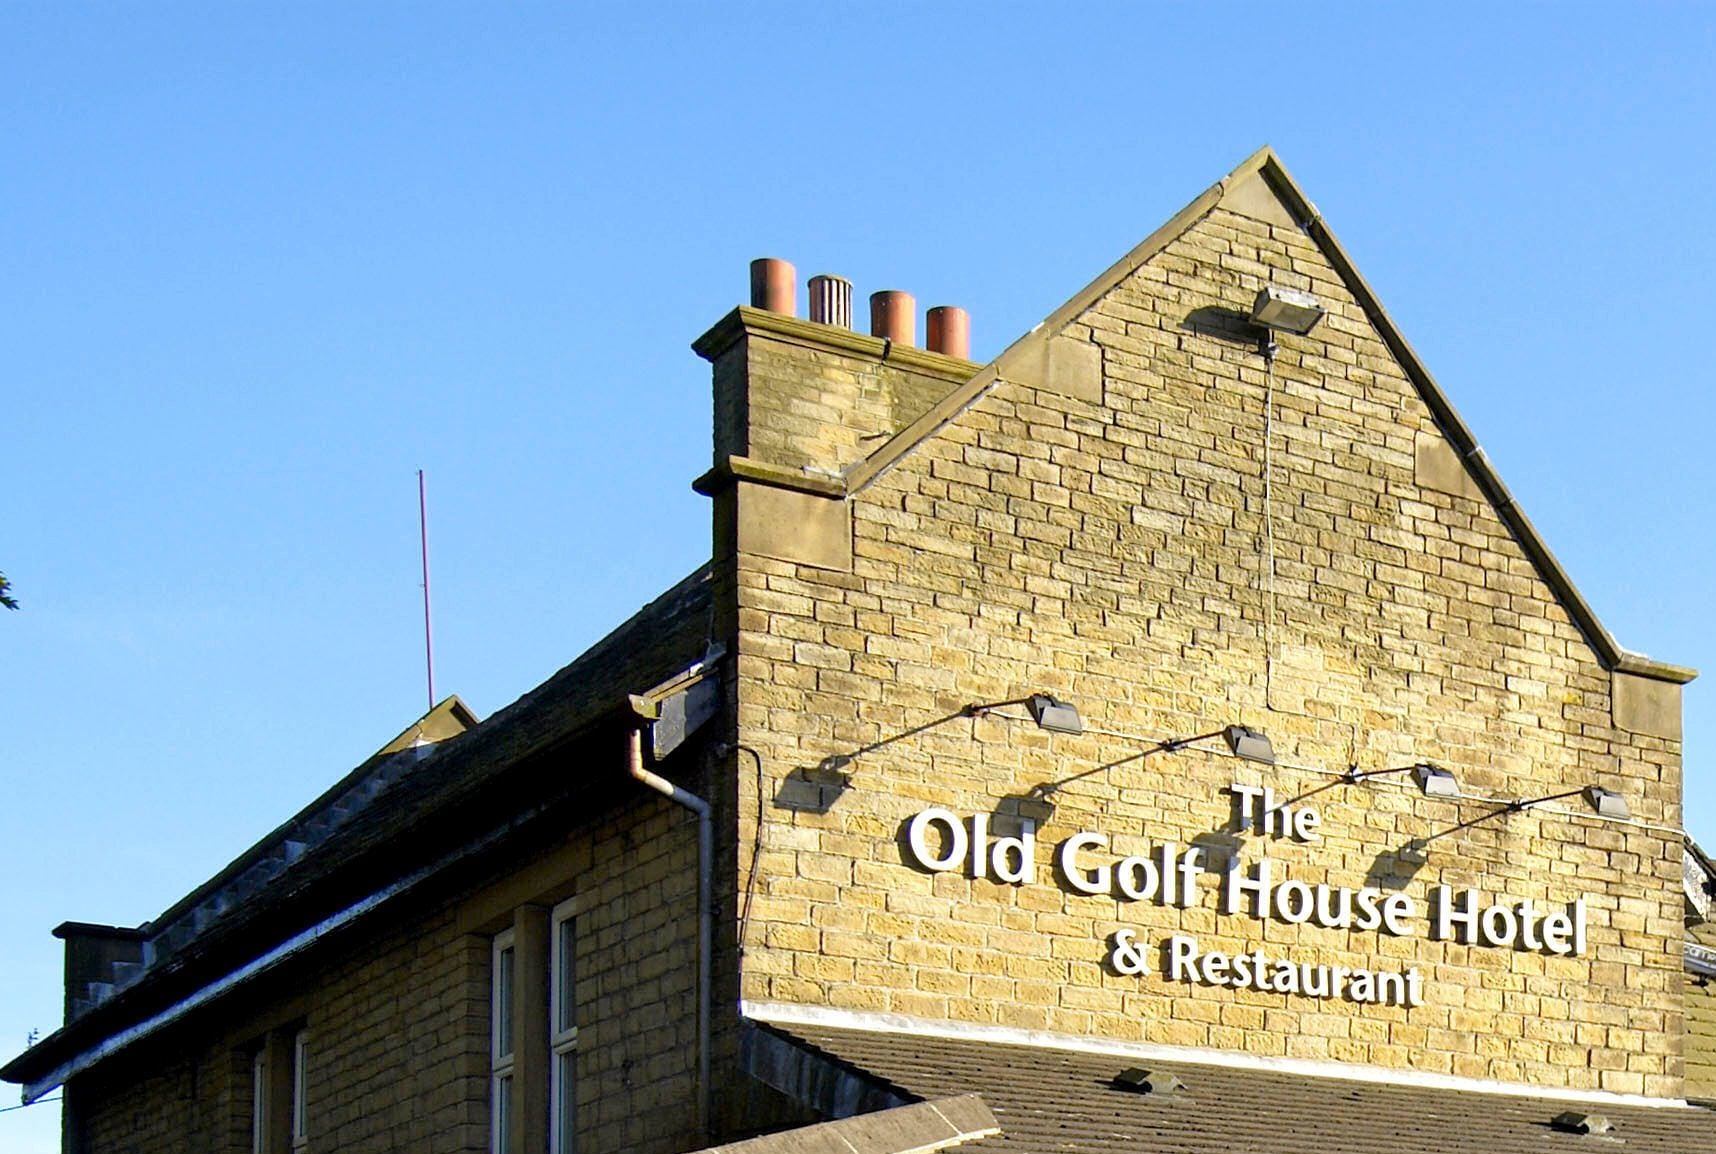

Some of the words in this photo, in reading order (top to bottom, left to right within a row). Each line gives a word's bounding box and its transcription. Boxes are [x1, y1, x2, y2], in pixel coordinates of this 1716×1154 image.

[1232, 784, 1322, 842] The
[909, 807, 1035, 885] Old
[1061, 831, 1206, 907] Golf
[1227, 857, 1416, 936] House
[1437, 885, 1587, 955] Hotel
[1112, 928, 1152, 976] &
[1171, 935, 1425, 1007] Restaurant
